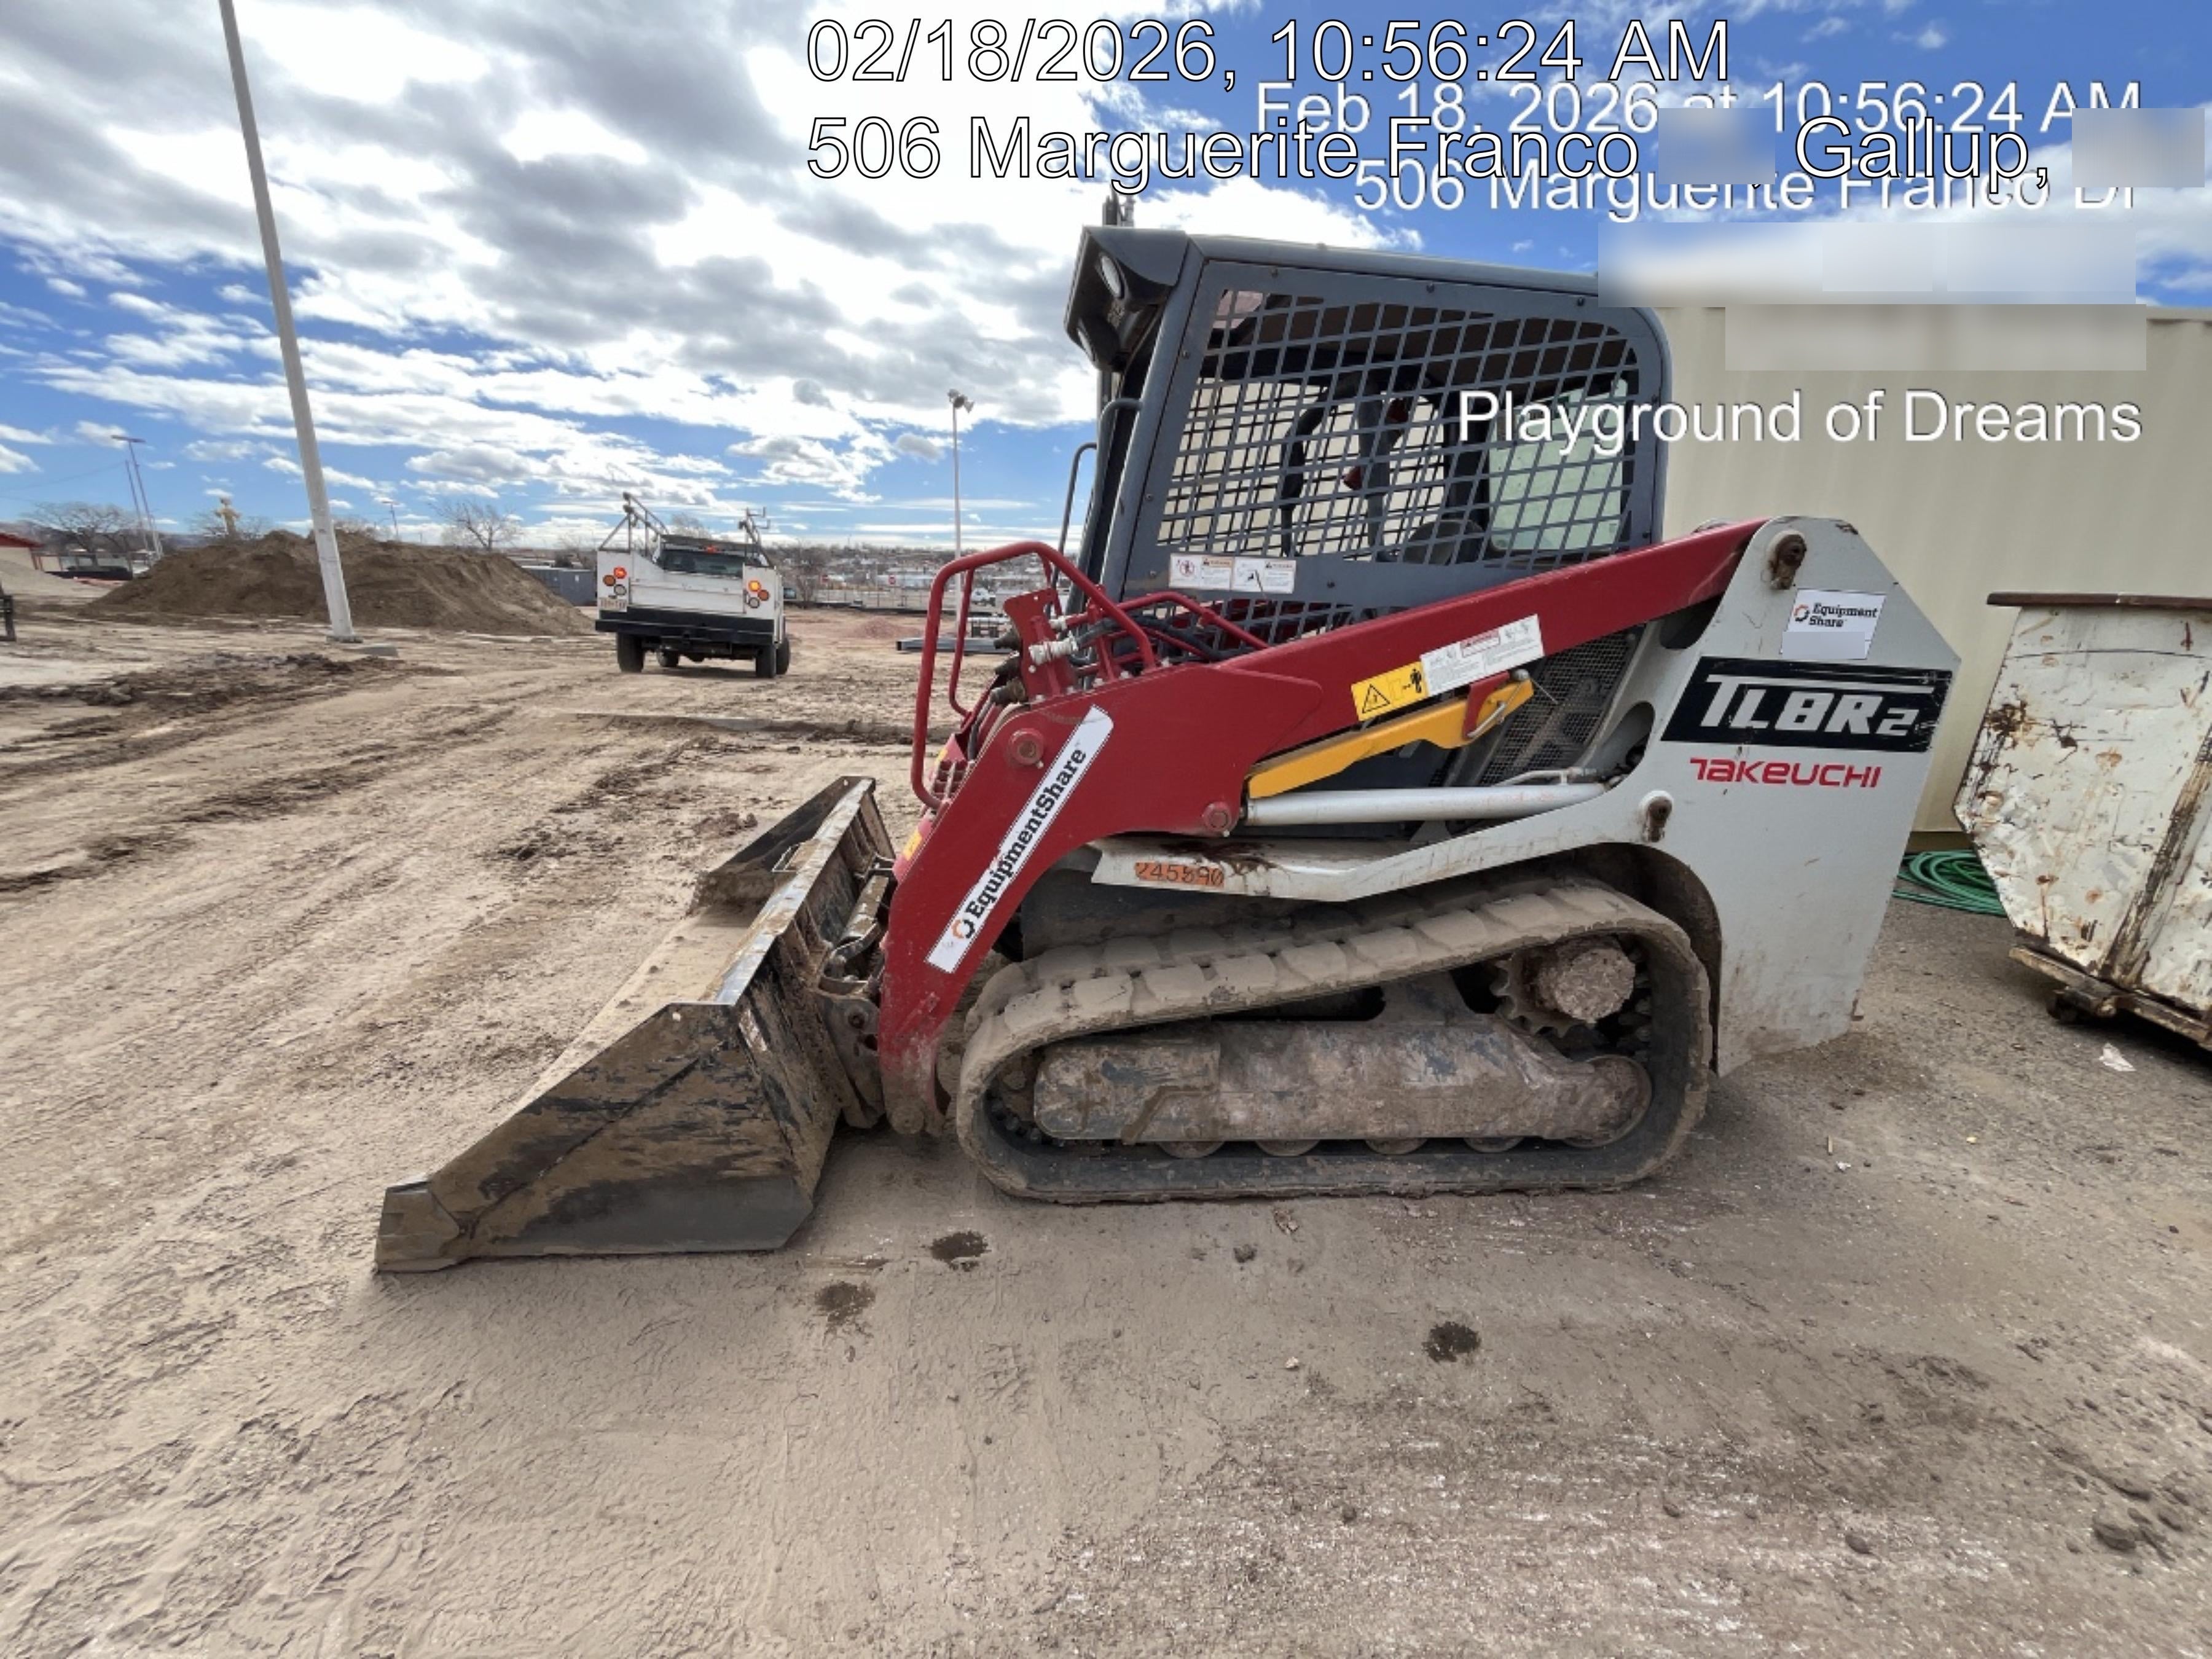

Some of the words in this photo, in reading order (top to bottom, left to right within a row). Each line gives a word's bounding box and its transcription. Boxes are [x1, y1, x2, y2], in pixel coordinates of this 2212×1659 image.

[1809, 615, 1844, 627] Share
[1813, 602, 1878, 618] Equipment
[1700, 675, 1935, 736] TL8R2
[965, 748, 1086, 919] EquipmentShare
